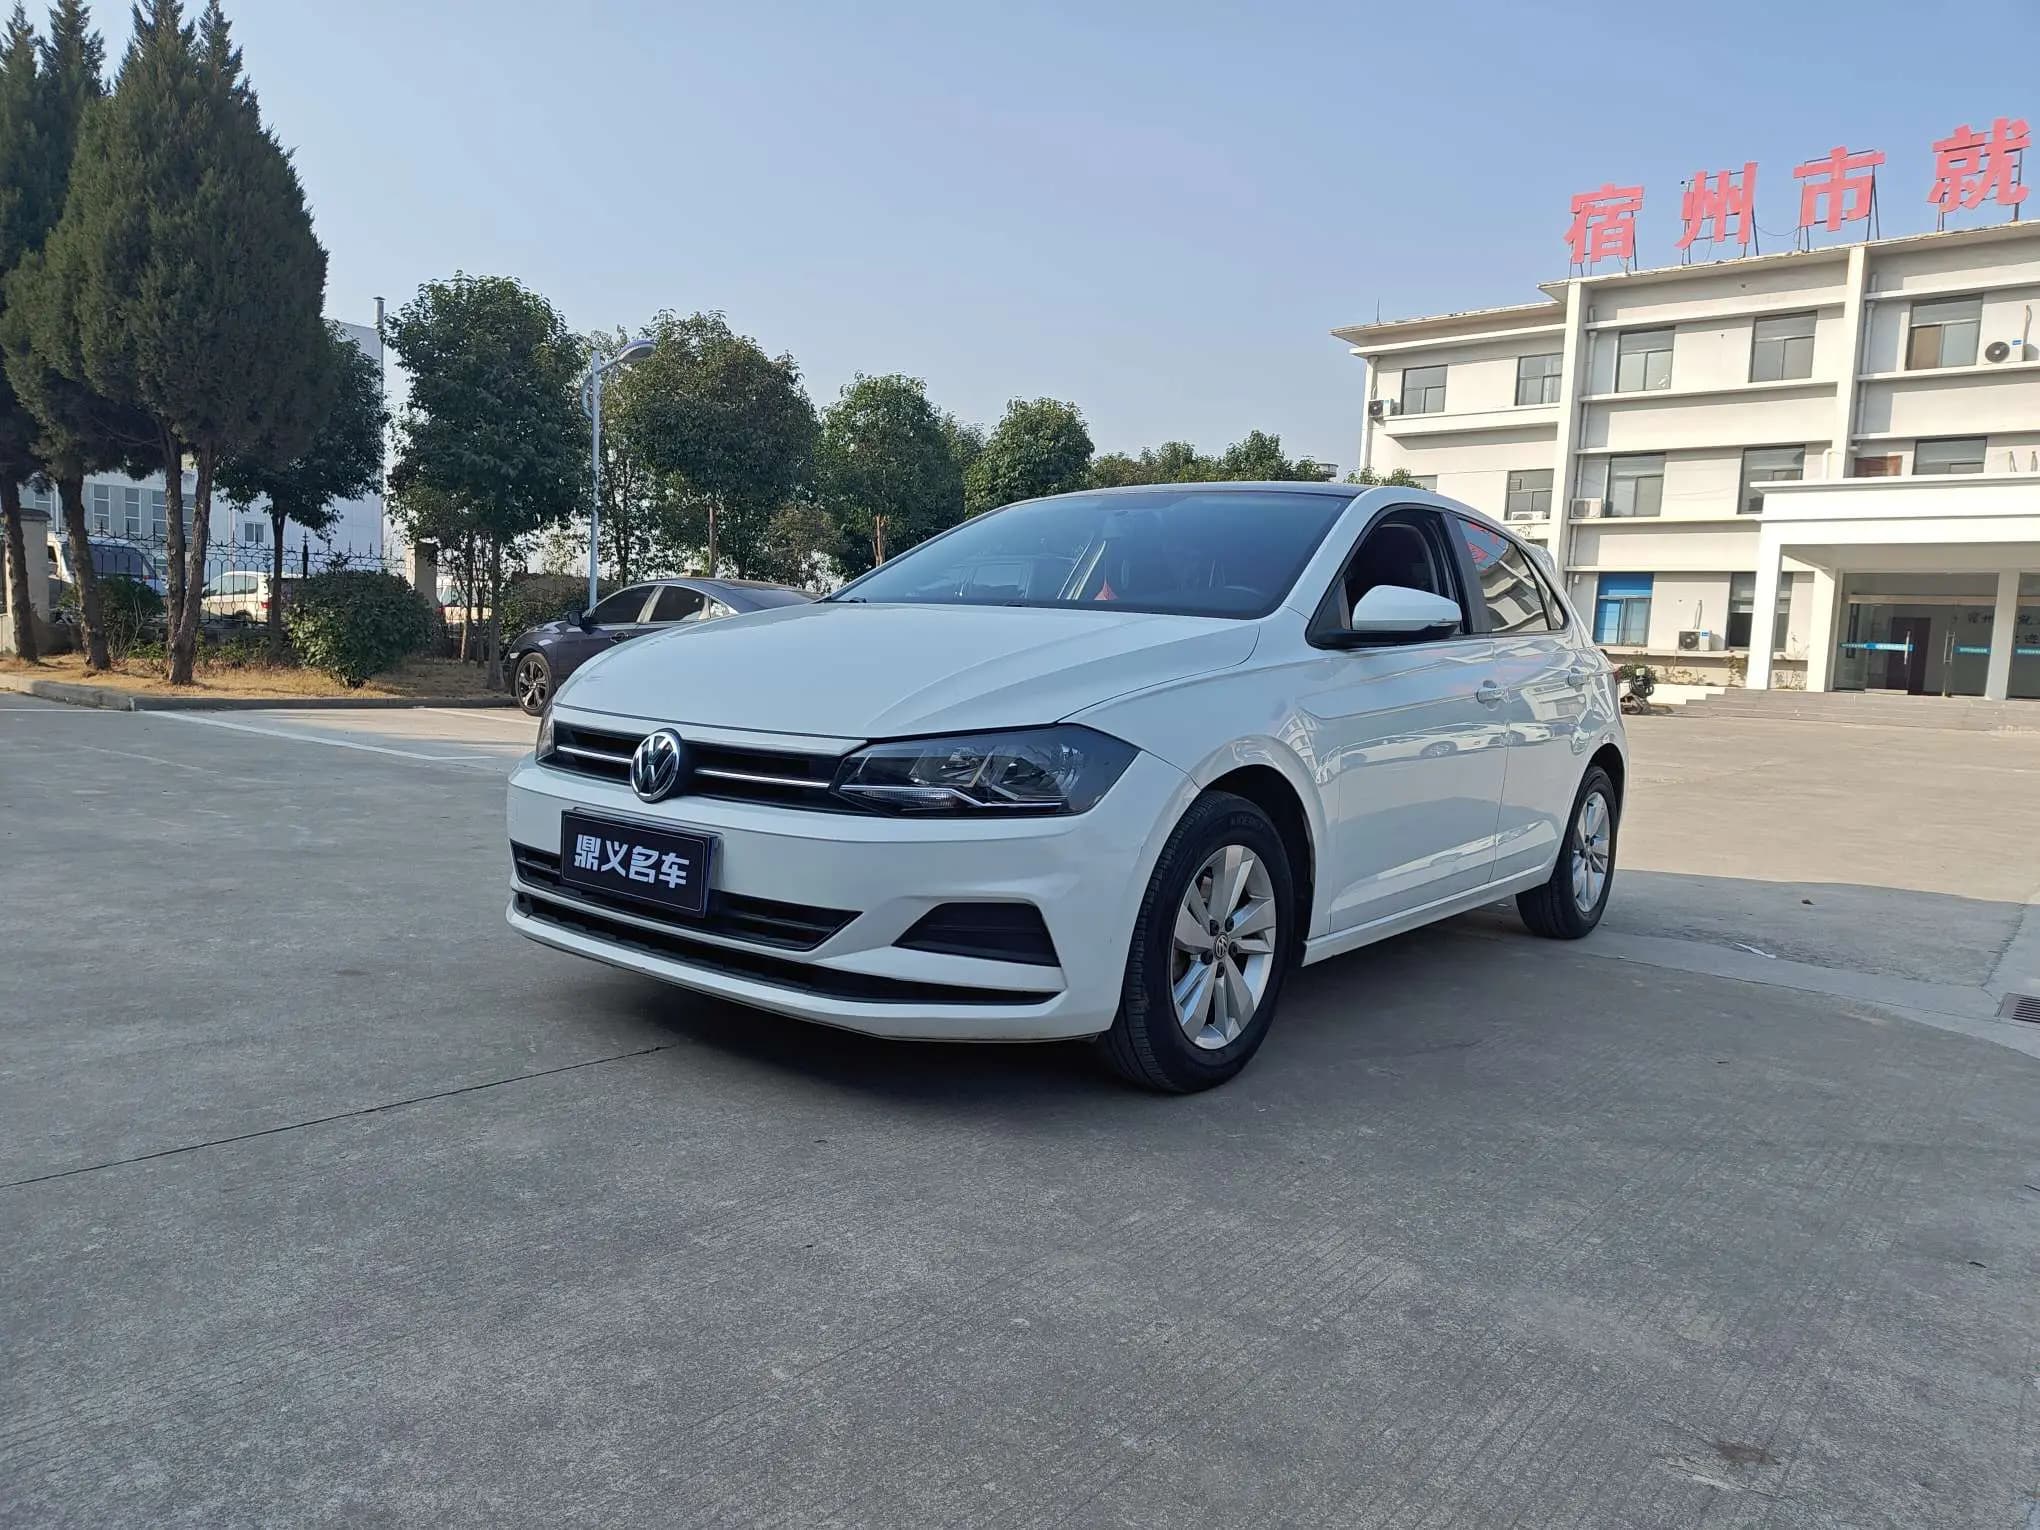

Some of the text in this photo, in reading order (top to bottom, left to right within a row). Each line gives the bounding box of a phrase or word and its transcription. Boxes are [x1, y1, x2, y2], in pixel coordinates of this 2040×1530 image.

[1564, 117, 2032, 264] 宿州市就
[574, 834, 690, 888] 鼎义名车
